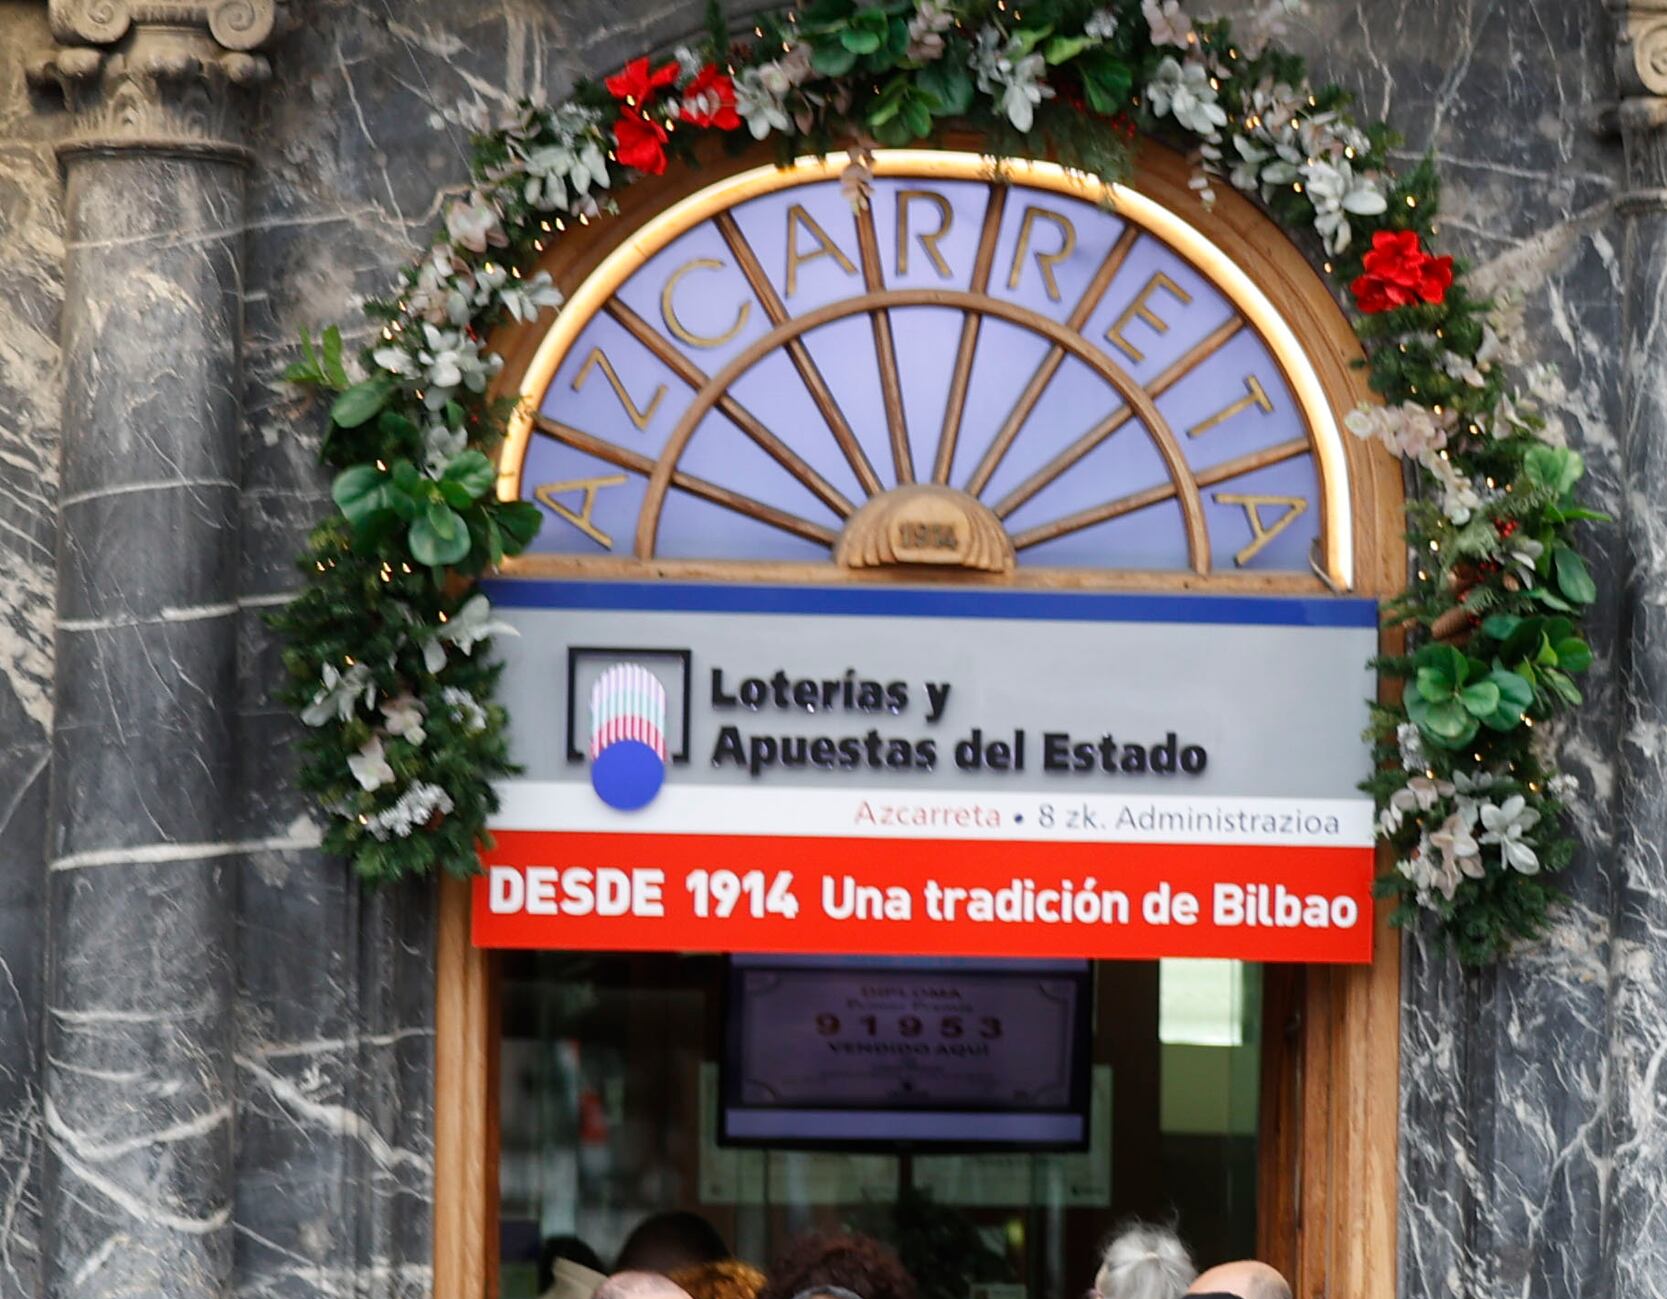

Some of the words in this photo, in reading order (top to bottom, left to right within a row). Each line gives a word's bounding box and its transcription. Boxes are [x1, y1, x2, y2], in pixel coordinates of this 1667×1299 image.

[534, 189, 1308, 567] AZCARRETA
[711, 667, 909, 713] Loterías
[924, 682, 951, 725] y
[711, 726, 937, 776] Apuestas
[955, 728, 1026, 771] del
[1043, 731, 1208, 775] Estado
[855, 801, 1001, 829] Azcarreta
[1038, 803, 1056, 829] 8
[1065, 803, 1108, 831] zk.
[1115, 805, 1341, 835] Administrazioa
[489, 865, 666, 918] DESDE
[686, 868, 800, 919] 1914
[821, 874, 913, 920] Una
[923, 876, 1129, 925] tradición
[1142, 881, 1200, 926] de
[1212, 882, 1359, 928] Bilbao
